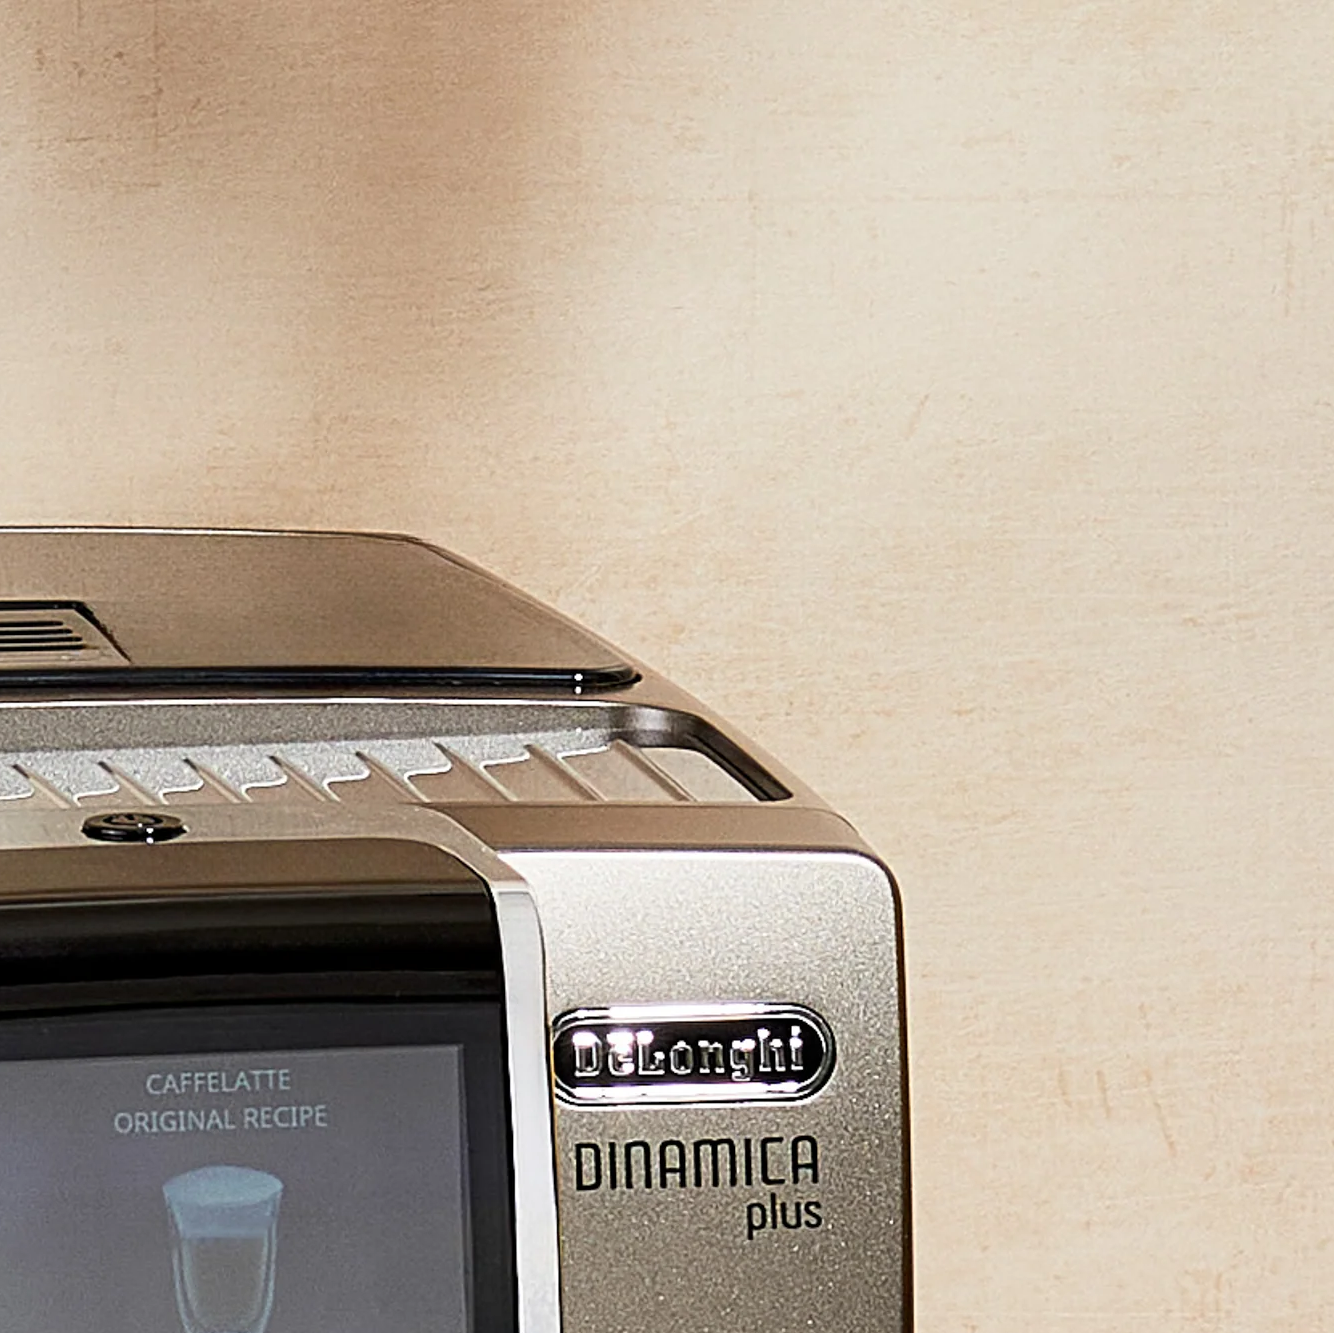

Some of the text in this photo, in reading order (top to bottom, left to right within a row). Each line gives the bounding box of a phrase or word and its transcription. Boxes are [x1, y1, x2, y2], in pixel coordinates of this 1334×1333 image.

[145, 1069, 292, 1096] CAFFELATTE
[113, 1104, 329, 1134] ORIGINAL RECIPE
[574, 1135, 820, 1191] DINAMICA
[745, 1192, 824, 1241] plus
